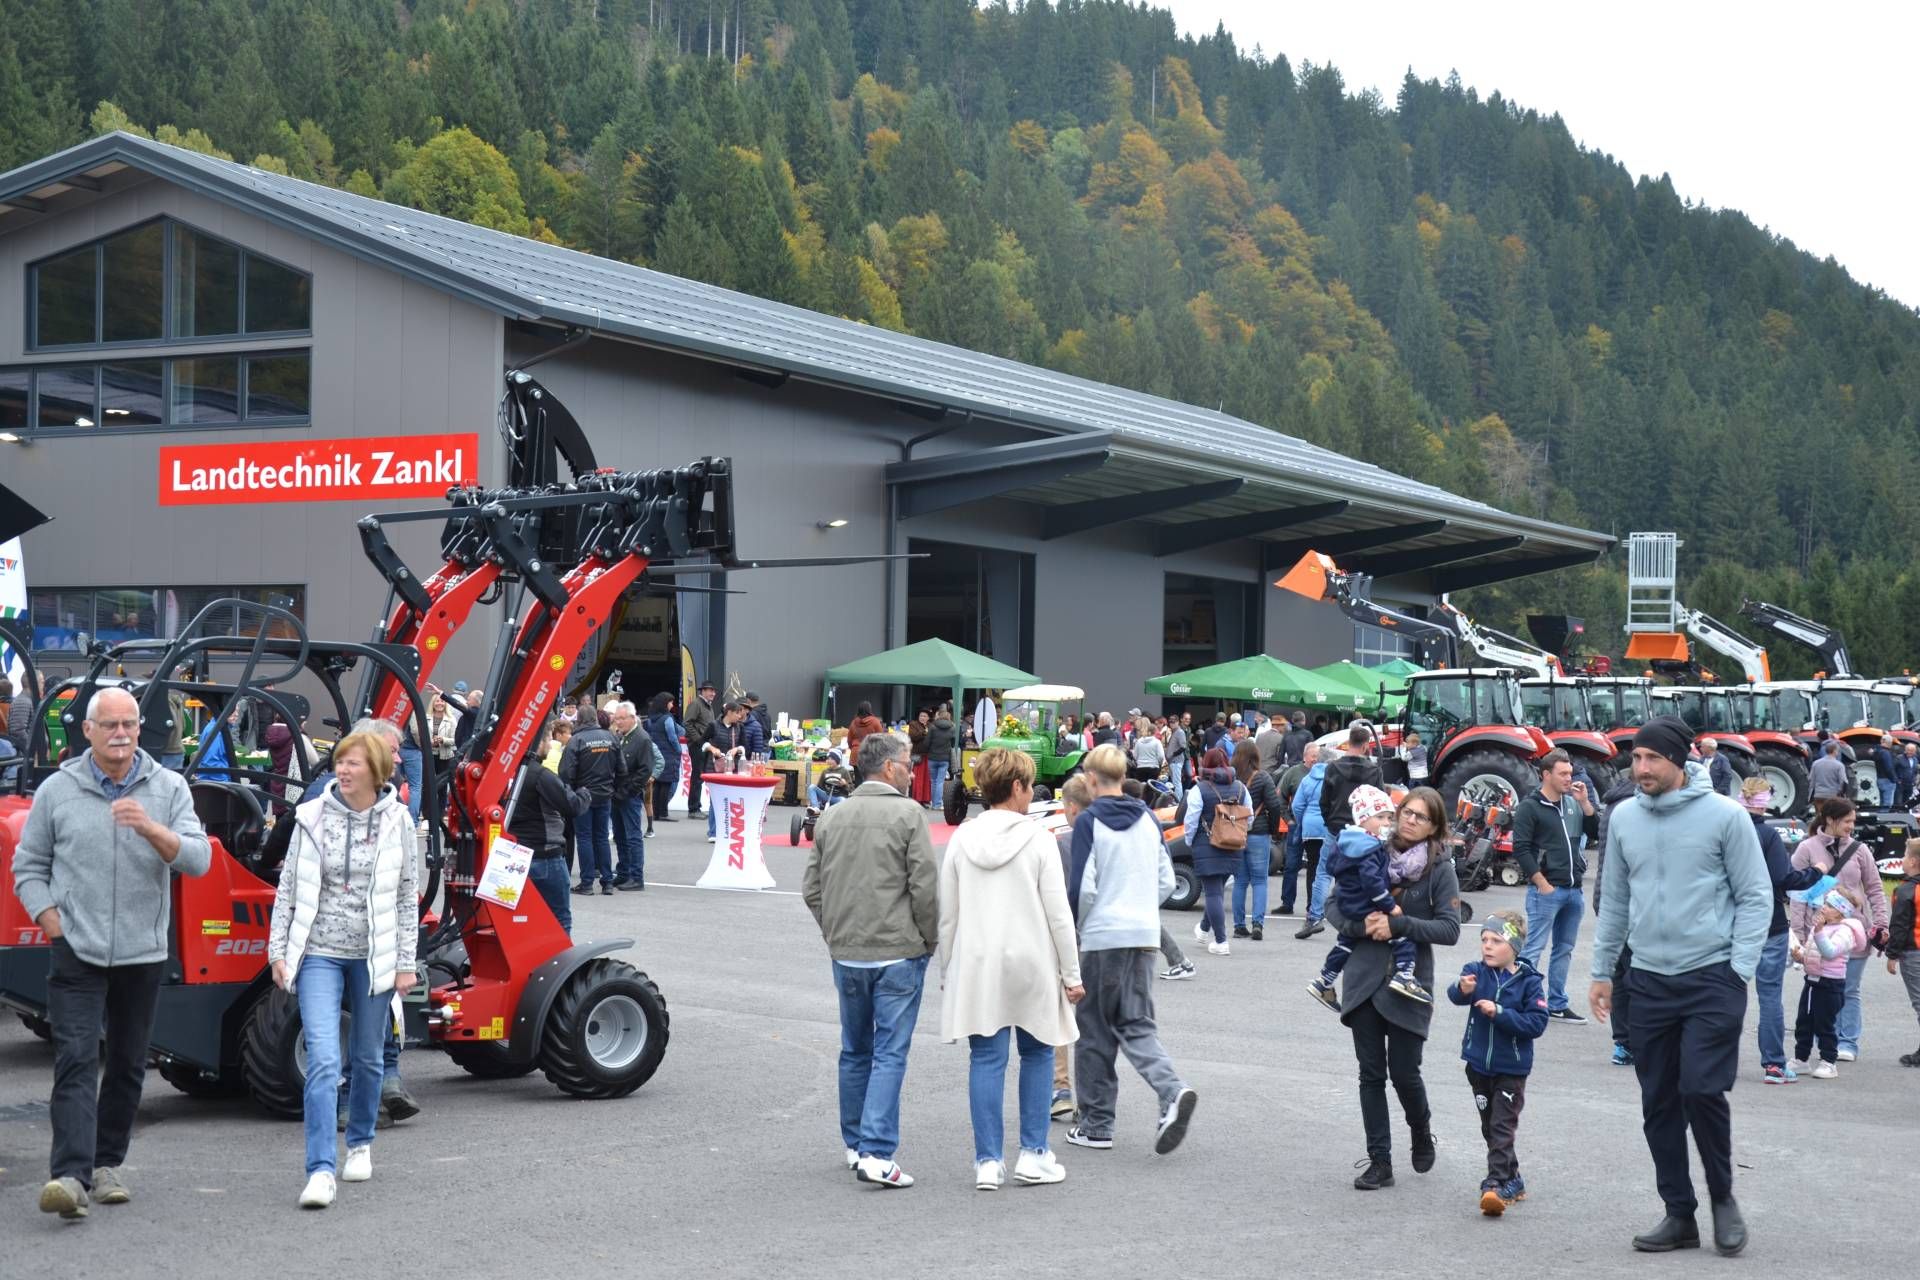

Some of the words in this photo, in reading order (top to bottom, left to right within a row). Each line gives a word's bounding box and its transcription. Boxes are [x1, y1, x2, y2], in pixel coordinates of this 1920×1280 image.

[173, 454, 362, 491] Landtechnik
[371, 448, 462, 485] Zankl
[500, 681, 549, 773] Schäffer
[728, 798, 745, 870] ZANKL
[216, 939, 268, 955] 202
